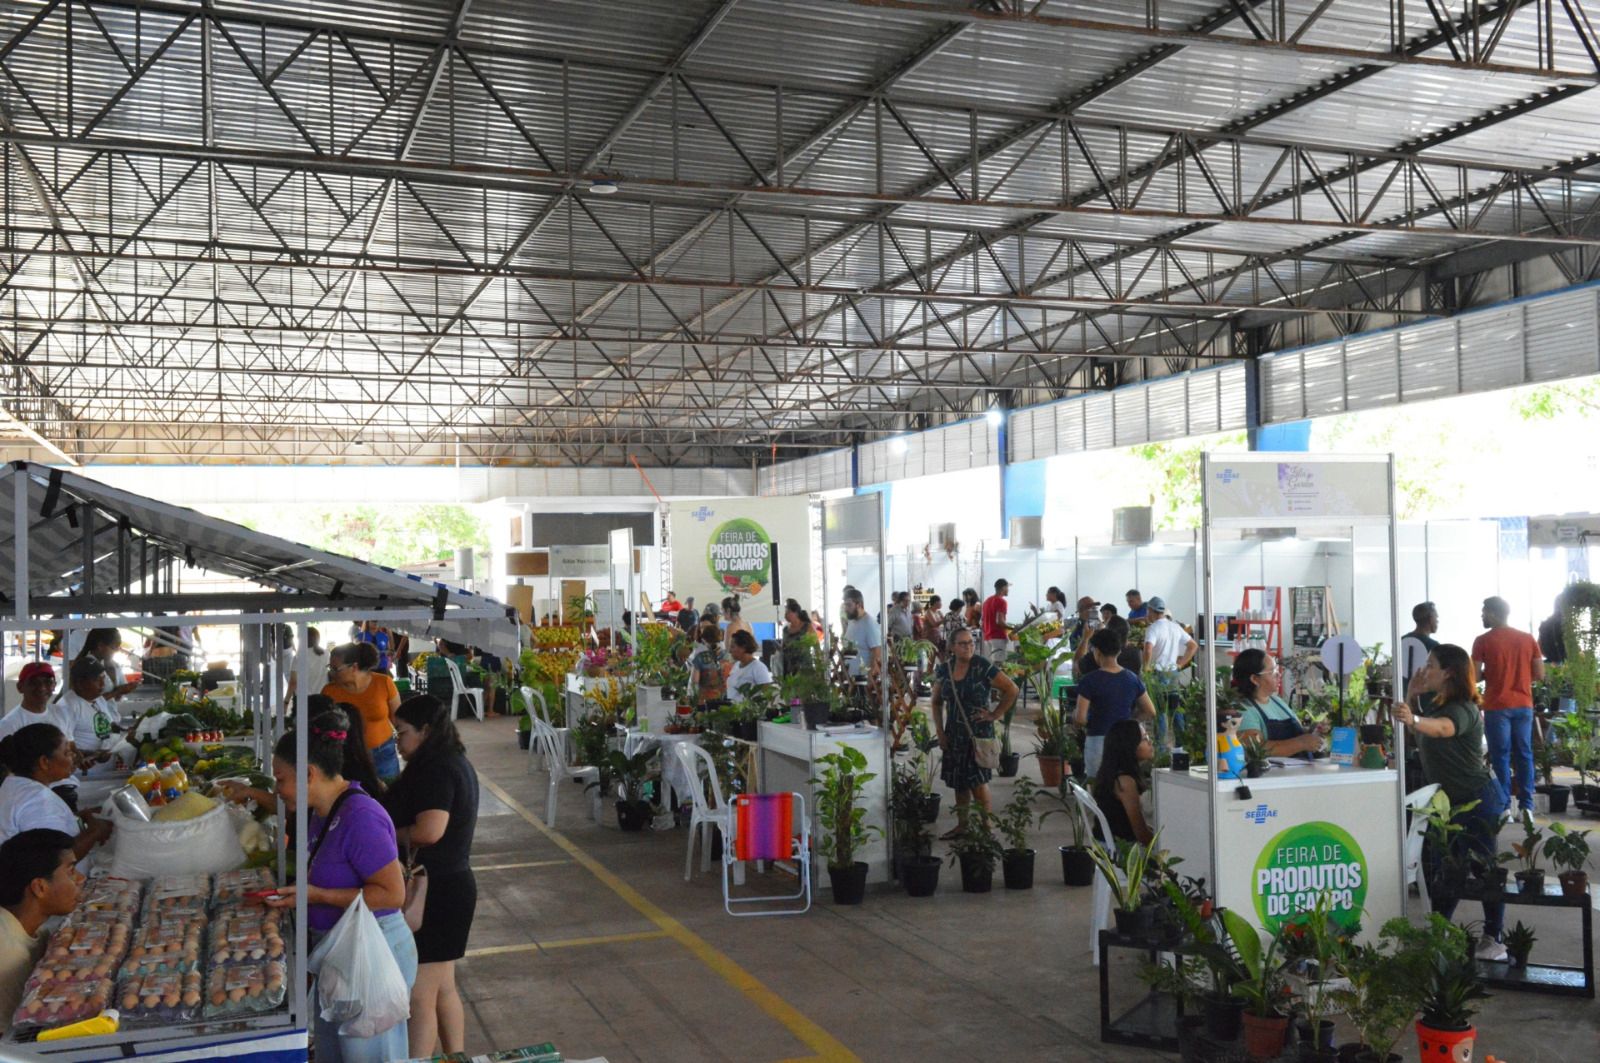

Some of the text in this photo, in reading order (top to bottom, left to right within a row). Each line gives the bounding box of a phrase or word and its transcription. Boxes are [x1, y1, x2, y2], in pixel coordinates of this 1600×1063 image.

[720, 532, 756, 541] FEIRA DE
[710, 543, 768, 558] PRODUTOS
[715, 559, 763, 570] DO CAMPO
[1245, 809, 1278, 819] SEBRAE
[1277, 845, 1341, 864] FEIRA DE
[1257, 862, 1361, 895] PRODUTOS
[1268, 894, 1289, 915] DO
